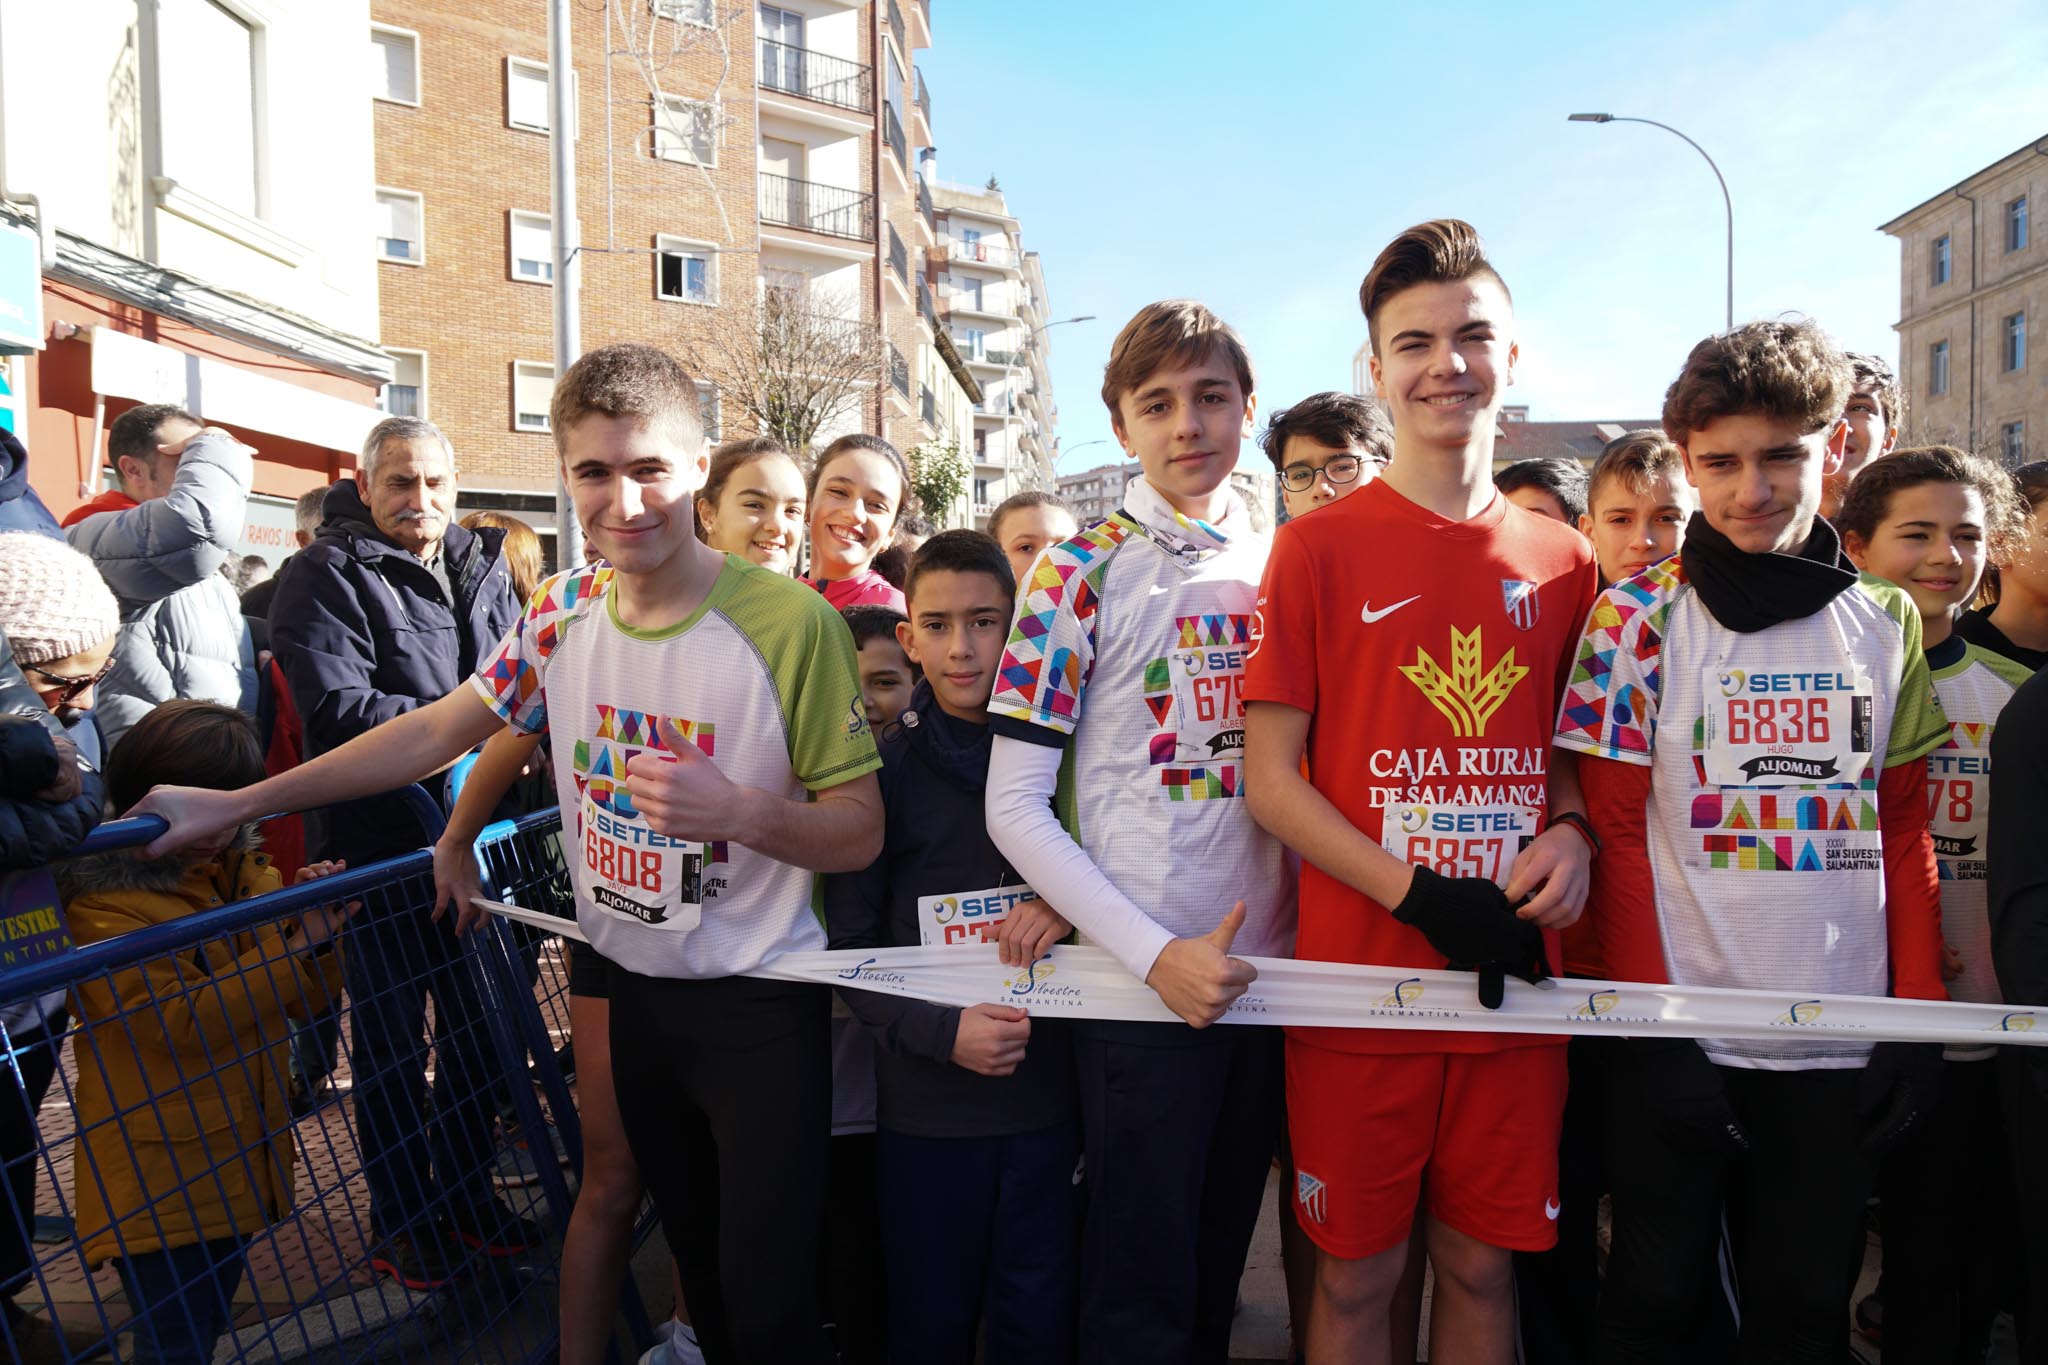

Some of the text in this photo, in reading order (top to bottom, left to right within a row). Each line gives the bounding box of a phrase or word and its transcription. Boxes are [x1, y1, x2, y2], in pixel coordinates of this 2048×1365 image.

[247, 525, 281, 546] RAYOS
[1749, 673, 1854, 692] SETEL
[1727, 698, 1830, 744] 6836
[1221, 733, 1245, 747] ALJO
[1767, 745, 1794, 754] HUGO
[1369, 747, 1546, 785] CAJA RURAL
[1758, 760, 1823, 777] ALJOMAR
[1369, 784, 1546, 808] DE SALAMANCA
[597, 814, 687, 848] SETEL
[1432, 812, 1523, 833] SETEL
[1825, 838, 1846, 848] XXXVI
[587, 827, 662, 893] 6808
[1406, 836, 1504, 882] 6857
[1826, 849, 1841, 859] SAN
[1826, 861, 1880, 871] SALMANTINA
[606, 881, 628, 894] JAVI
[600, 891, 651, 922] ALJOMAR
[1001, 996, 1084, 1007] SALMANTINA
[1370, 1009, 1461, 1018] SALMANTINA
